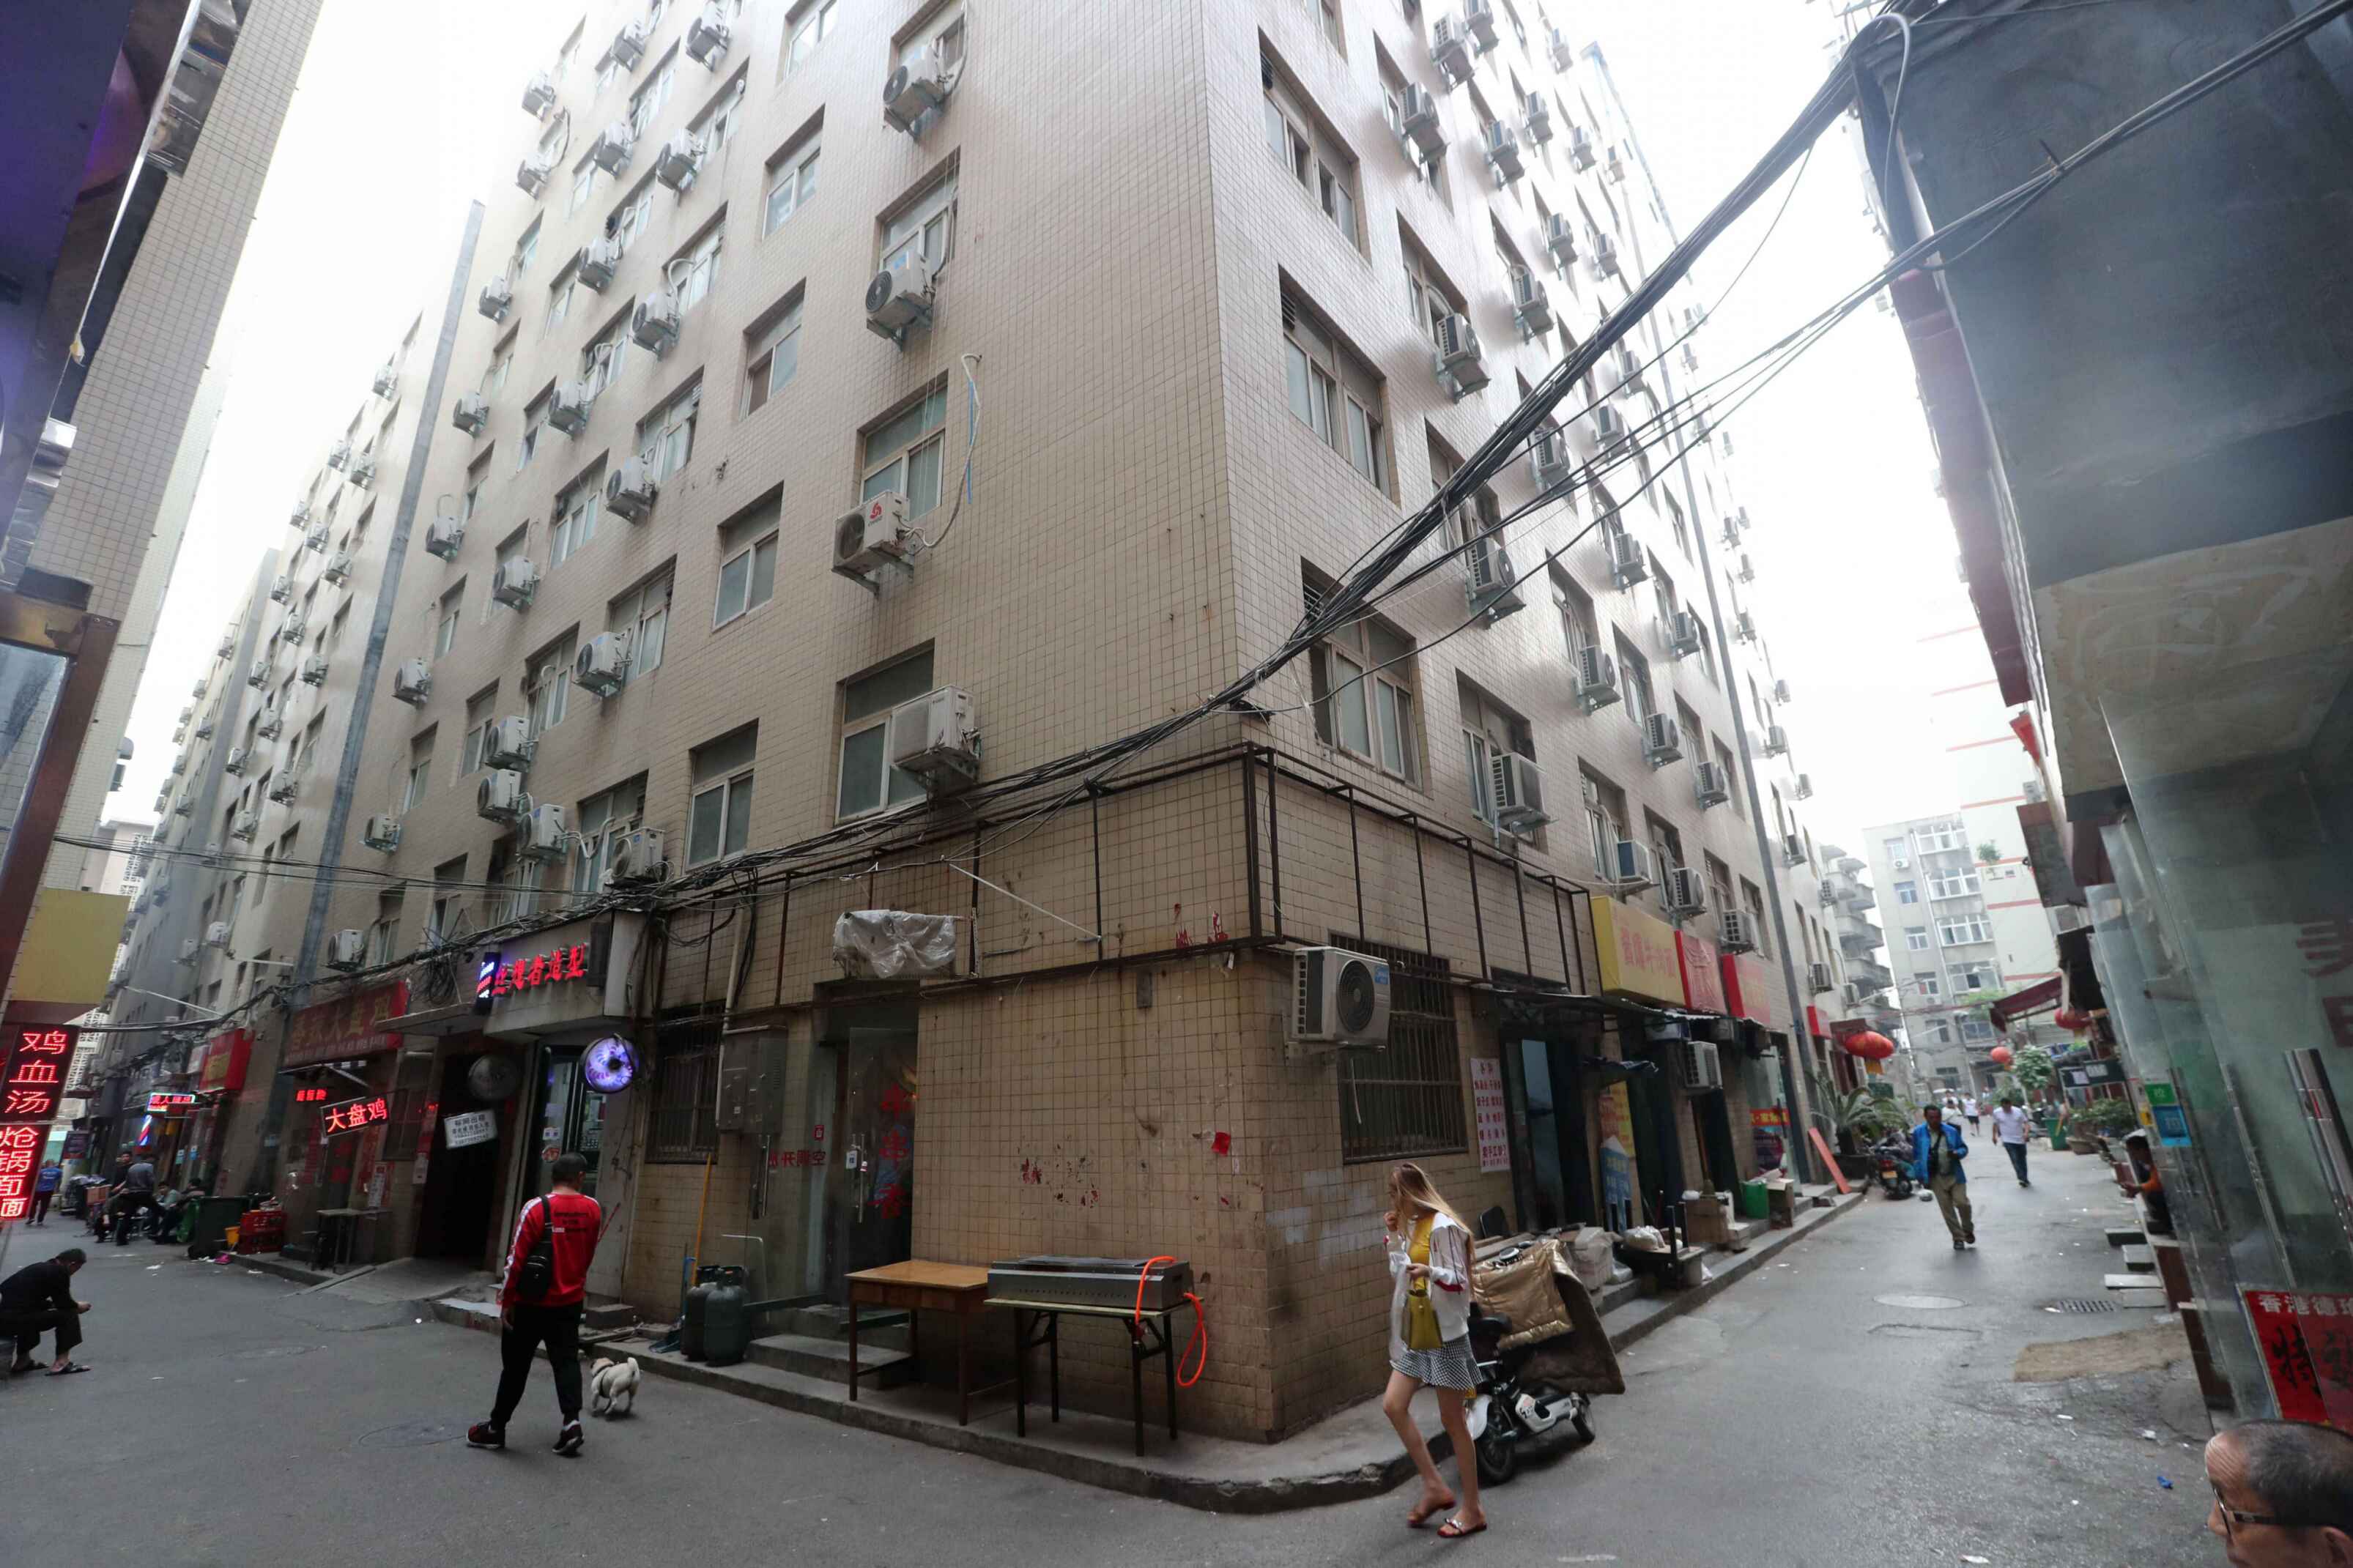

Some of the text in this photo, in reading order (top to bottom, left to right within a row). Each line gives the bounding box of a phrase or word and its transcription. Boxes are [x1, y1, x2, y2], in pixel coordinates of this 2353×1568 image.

[4, 1030, 67, 1113] 鸡血汤
[325, 1098, 387, 1132] 大盘鸡
